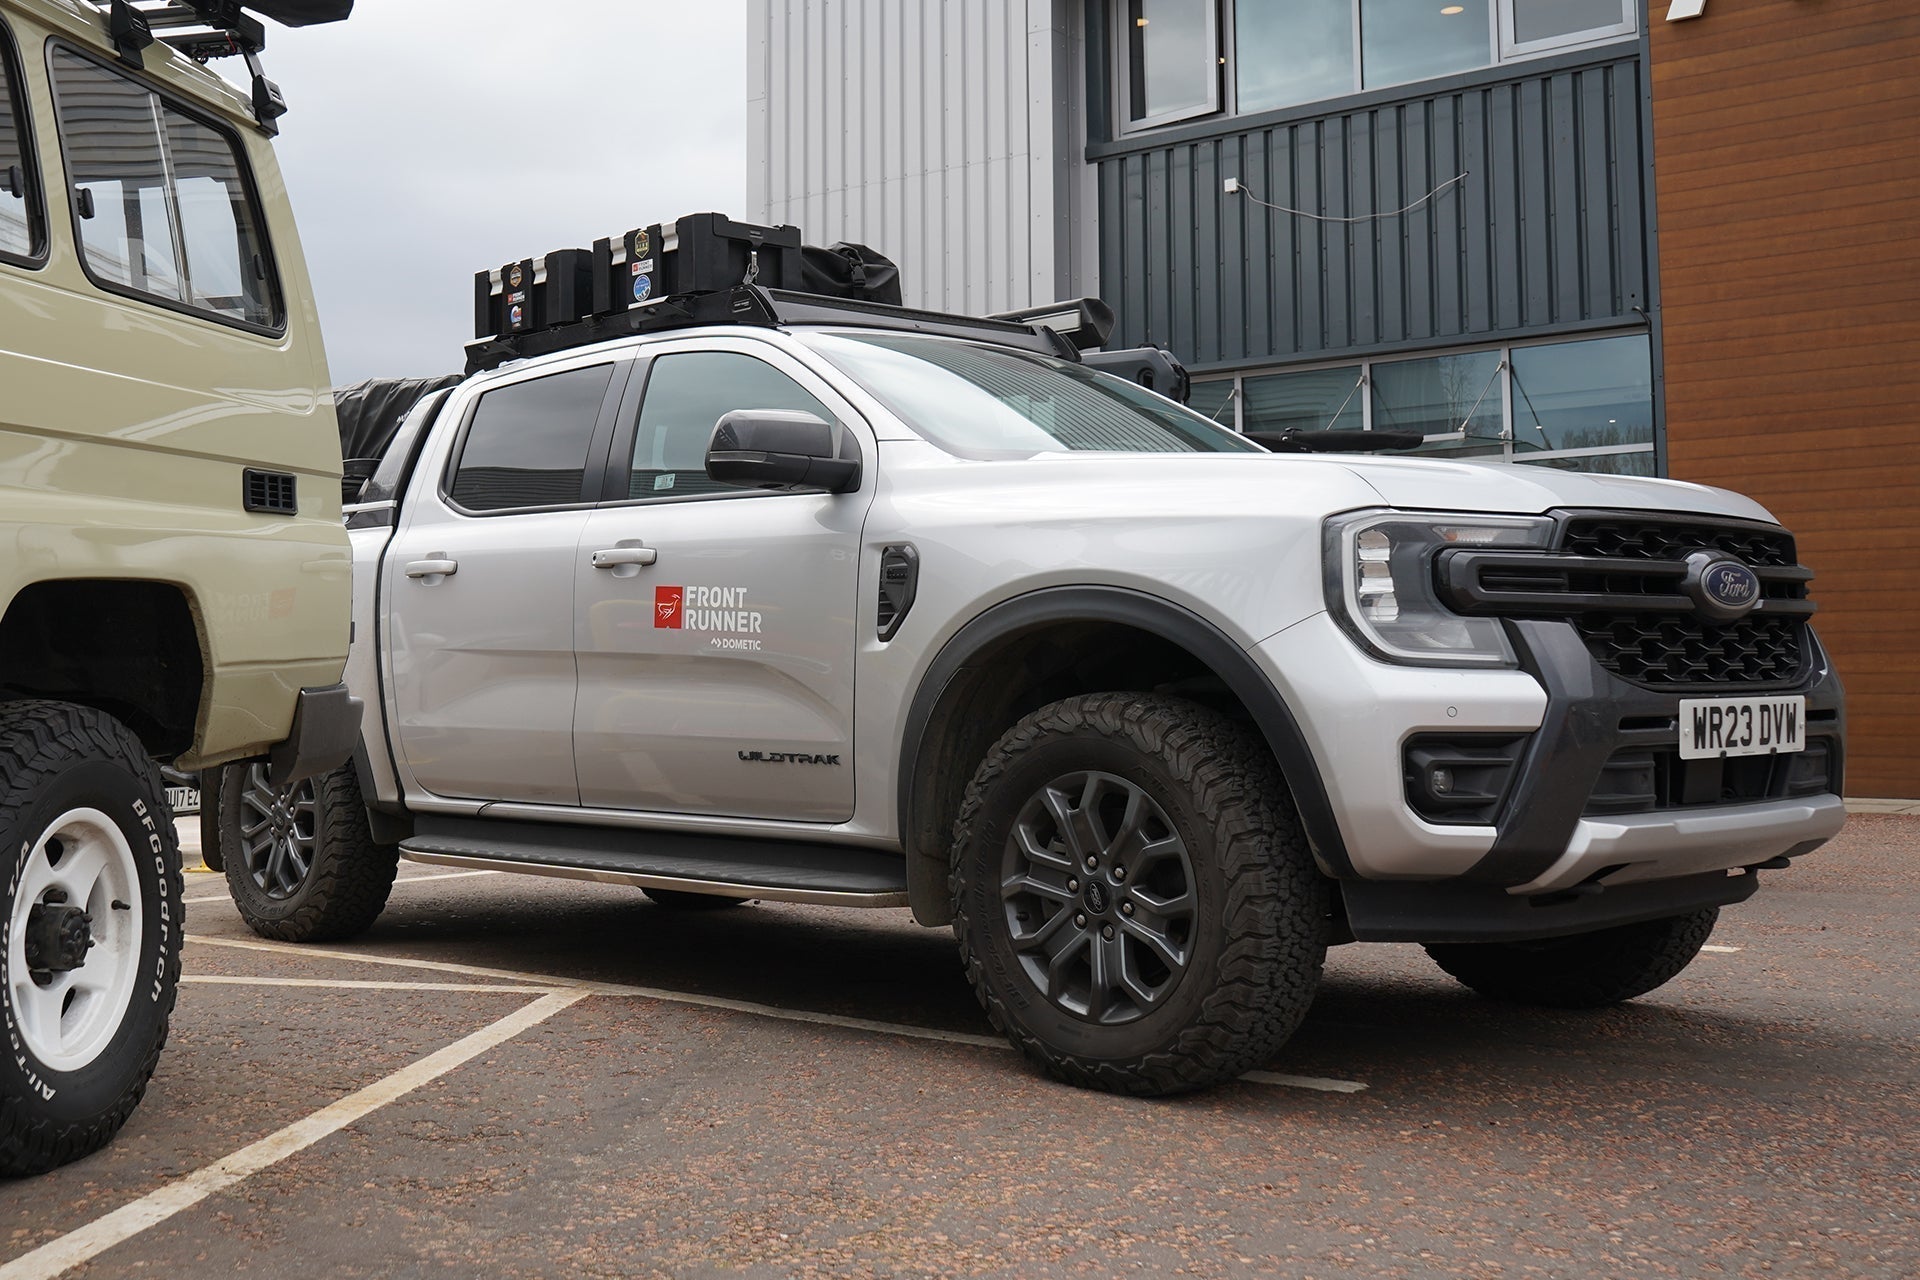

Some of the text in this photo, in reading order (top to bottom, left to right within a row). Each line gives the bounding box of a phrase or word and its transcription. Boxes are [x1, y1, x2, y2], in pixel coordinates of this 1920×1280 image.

[1720, 570, 1750, 597] Ford
[686, 586, 747, 608] FRONT
[685, 609, 762, 633] RUNNER
[722, 638, 761, 650] DOMETIC
[1693, 703, 1796, 749] WR23 DVW
[738, 750, 841, 766] WILDTRAK
[165, 789, 185, 807] U17
[132, 798, 170, 1002] BFGoodrich
